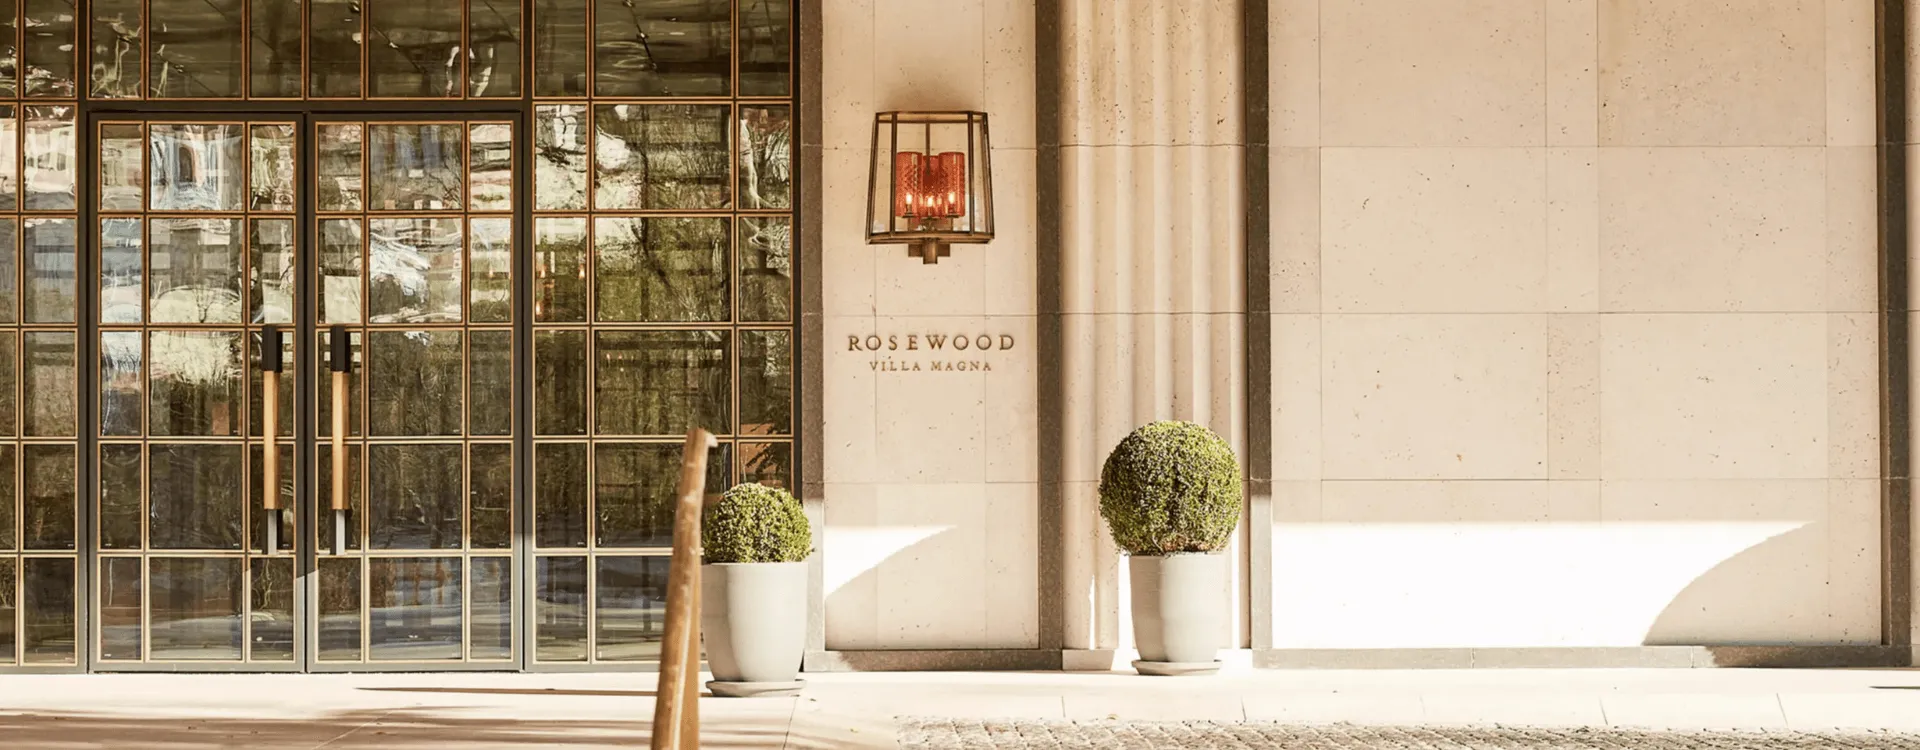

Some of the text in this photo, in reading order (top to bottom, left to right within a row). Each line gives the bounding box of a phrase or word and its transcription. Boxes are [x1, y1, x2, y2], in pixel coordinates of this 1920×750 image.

[848, 334, 1015, 351] ROSEWOOD
[869, 361, 992, 372] VILLA MAGNA
